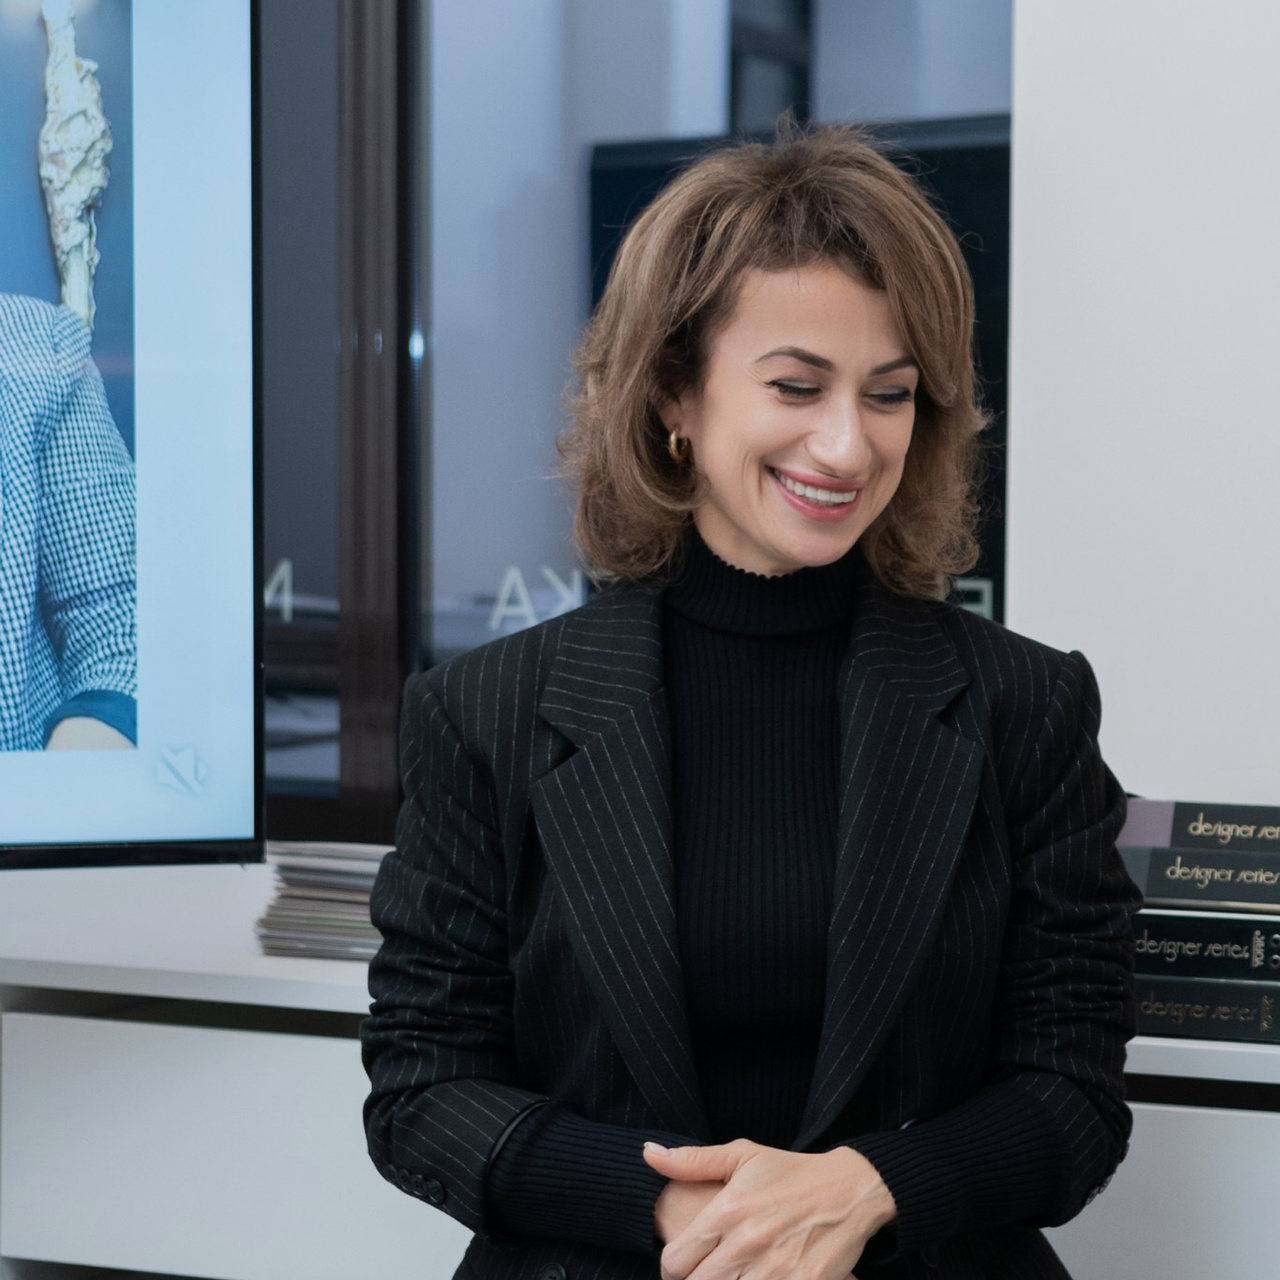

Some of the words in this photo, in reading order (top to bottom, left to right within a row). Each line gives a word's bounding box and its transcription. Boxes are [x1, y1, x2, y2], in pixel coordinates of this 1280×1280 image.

[1188, 811, 1256, 844] designer
[1166, 856, 1234, 888] designer
[1235, 869, 1280, 885] series
[1136, 929, 1202, 962] designer
[1141, 991, 1210, 1023] designer
